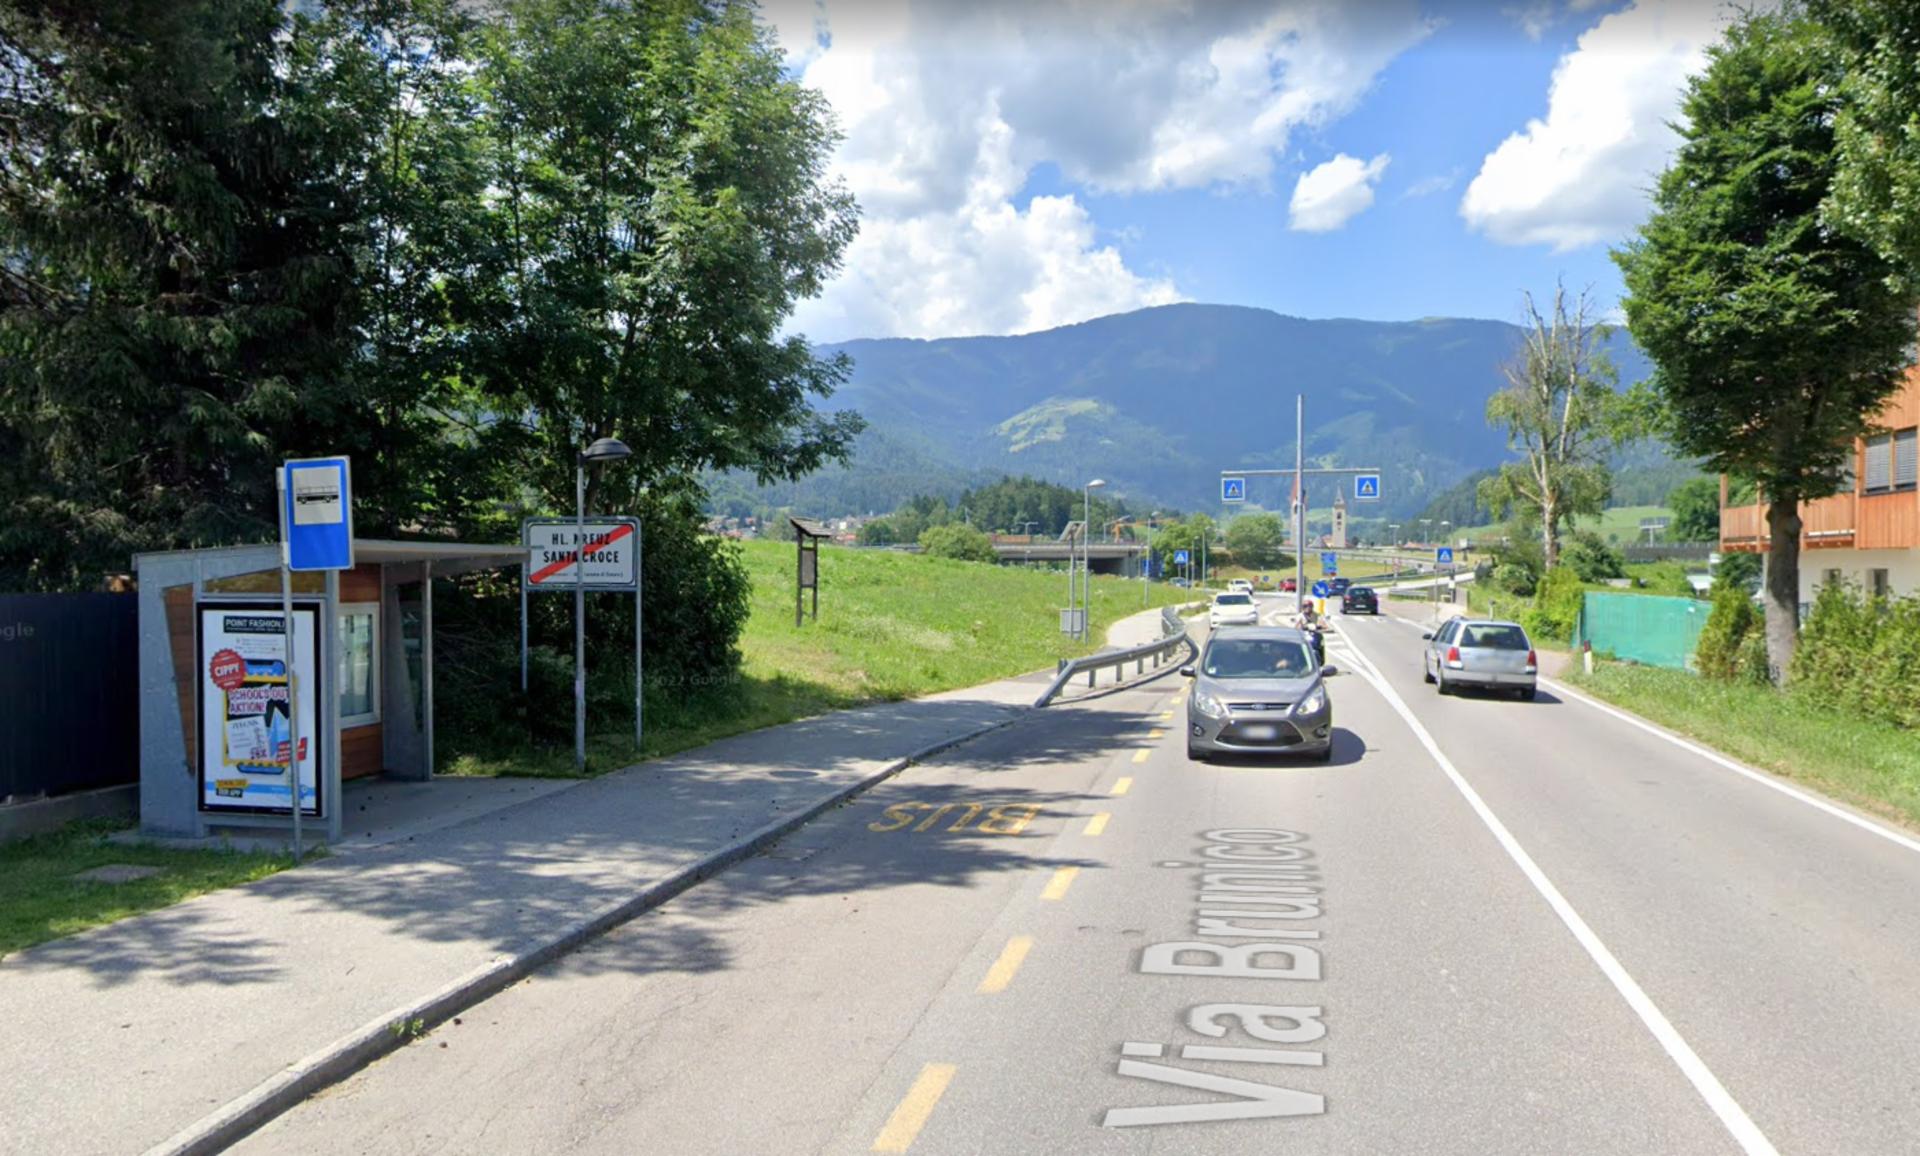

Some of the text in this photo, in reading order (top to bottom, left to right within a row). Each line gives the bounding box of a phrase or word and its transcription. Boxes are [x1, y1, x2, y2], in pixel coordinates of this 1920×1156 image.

[552, 533, 568, 545] HL.
[543, 551, 619, 563] SANTA CROCE
[226, 618, 248, 627] POINT
[867, 801, 1042, 836] BUS
